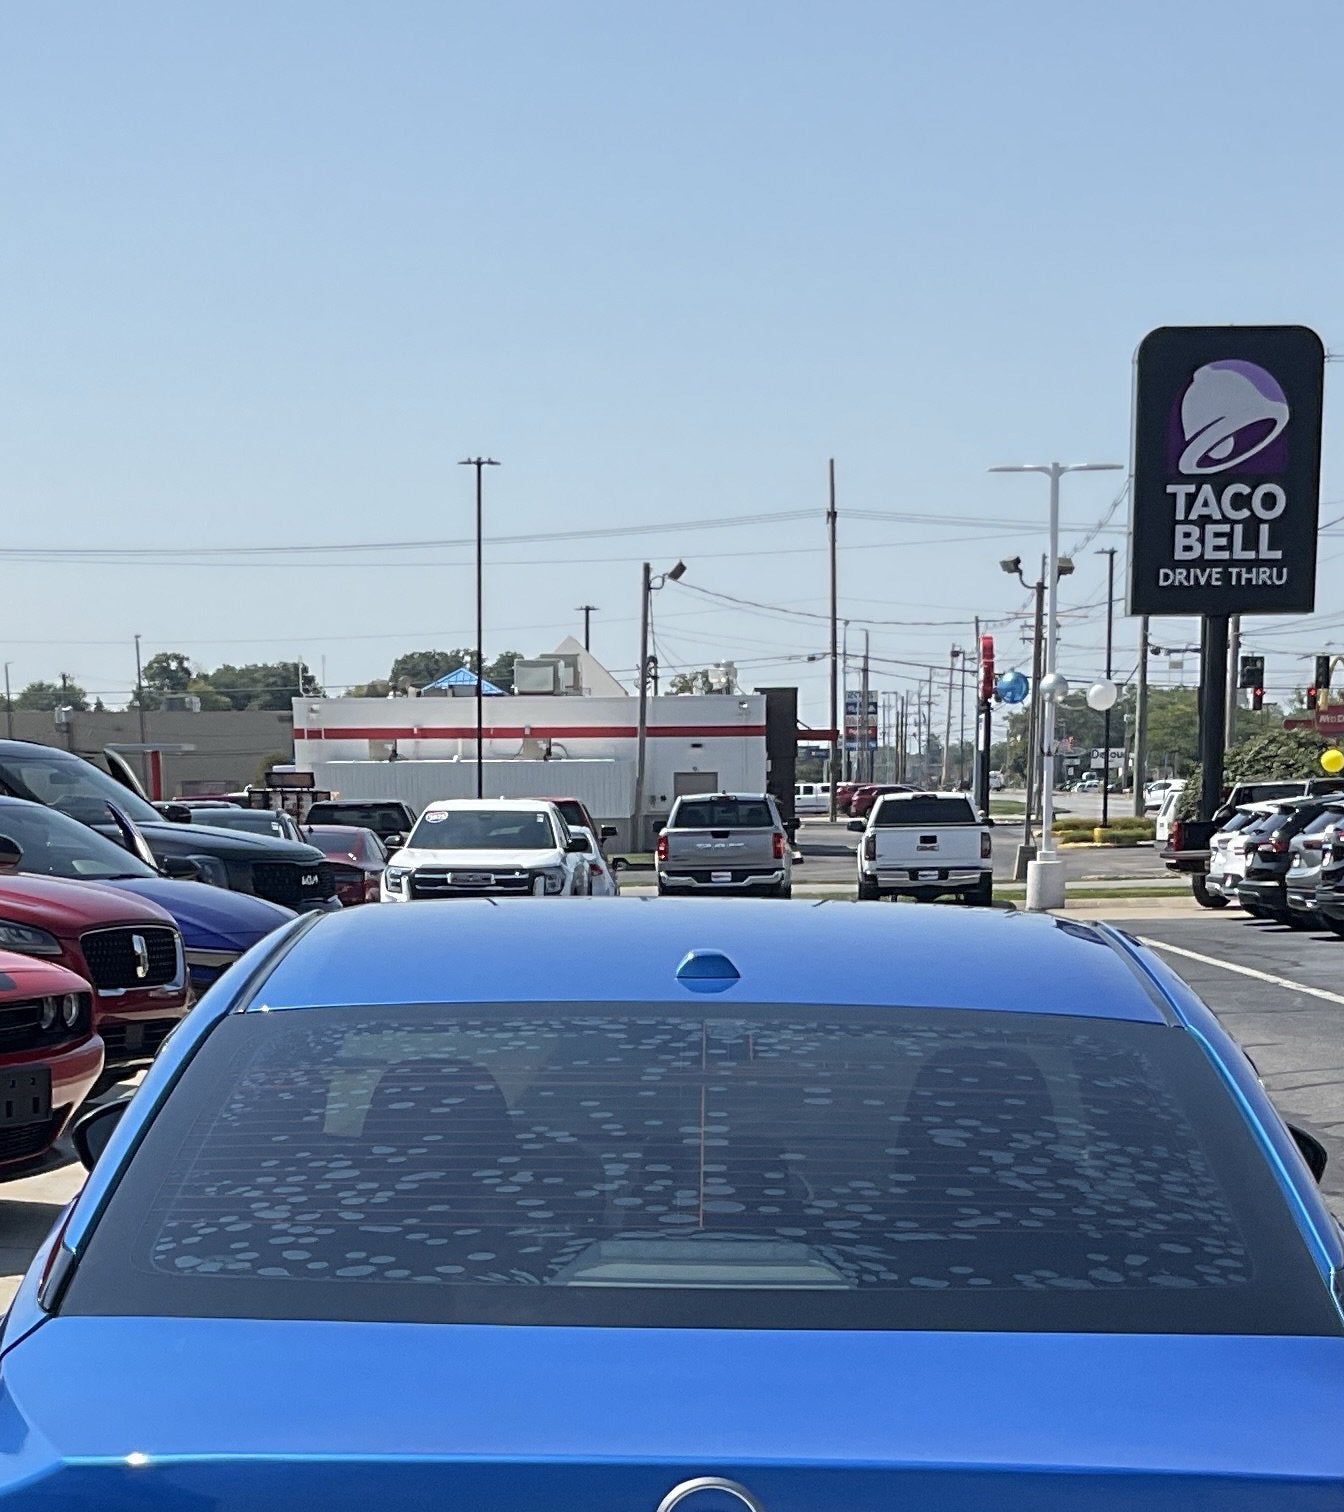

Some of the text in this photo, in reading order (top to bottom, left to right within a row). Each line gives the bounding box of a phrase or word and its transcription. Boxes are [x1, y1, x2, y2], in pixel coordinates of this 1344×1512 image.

[1166, 483, 1286, 520] TACO
[1173, 524, 1282, 561] BELL
[1158, 567, 1288, 587] DRIVE THRU
